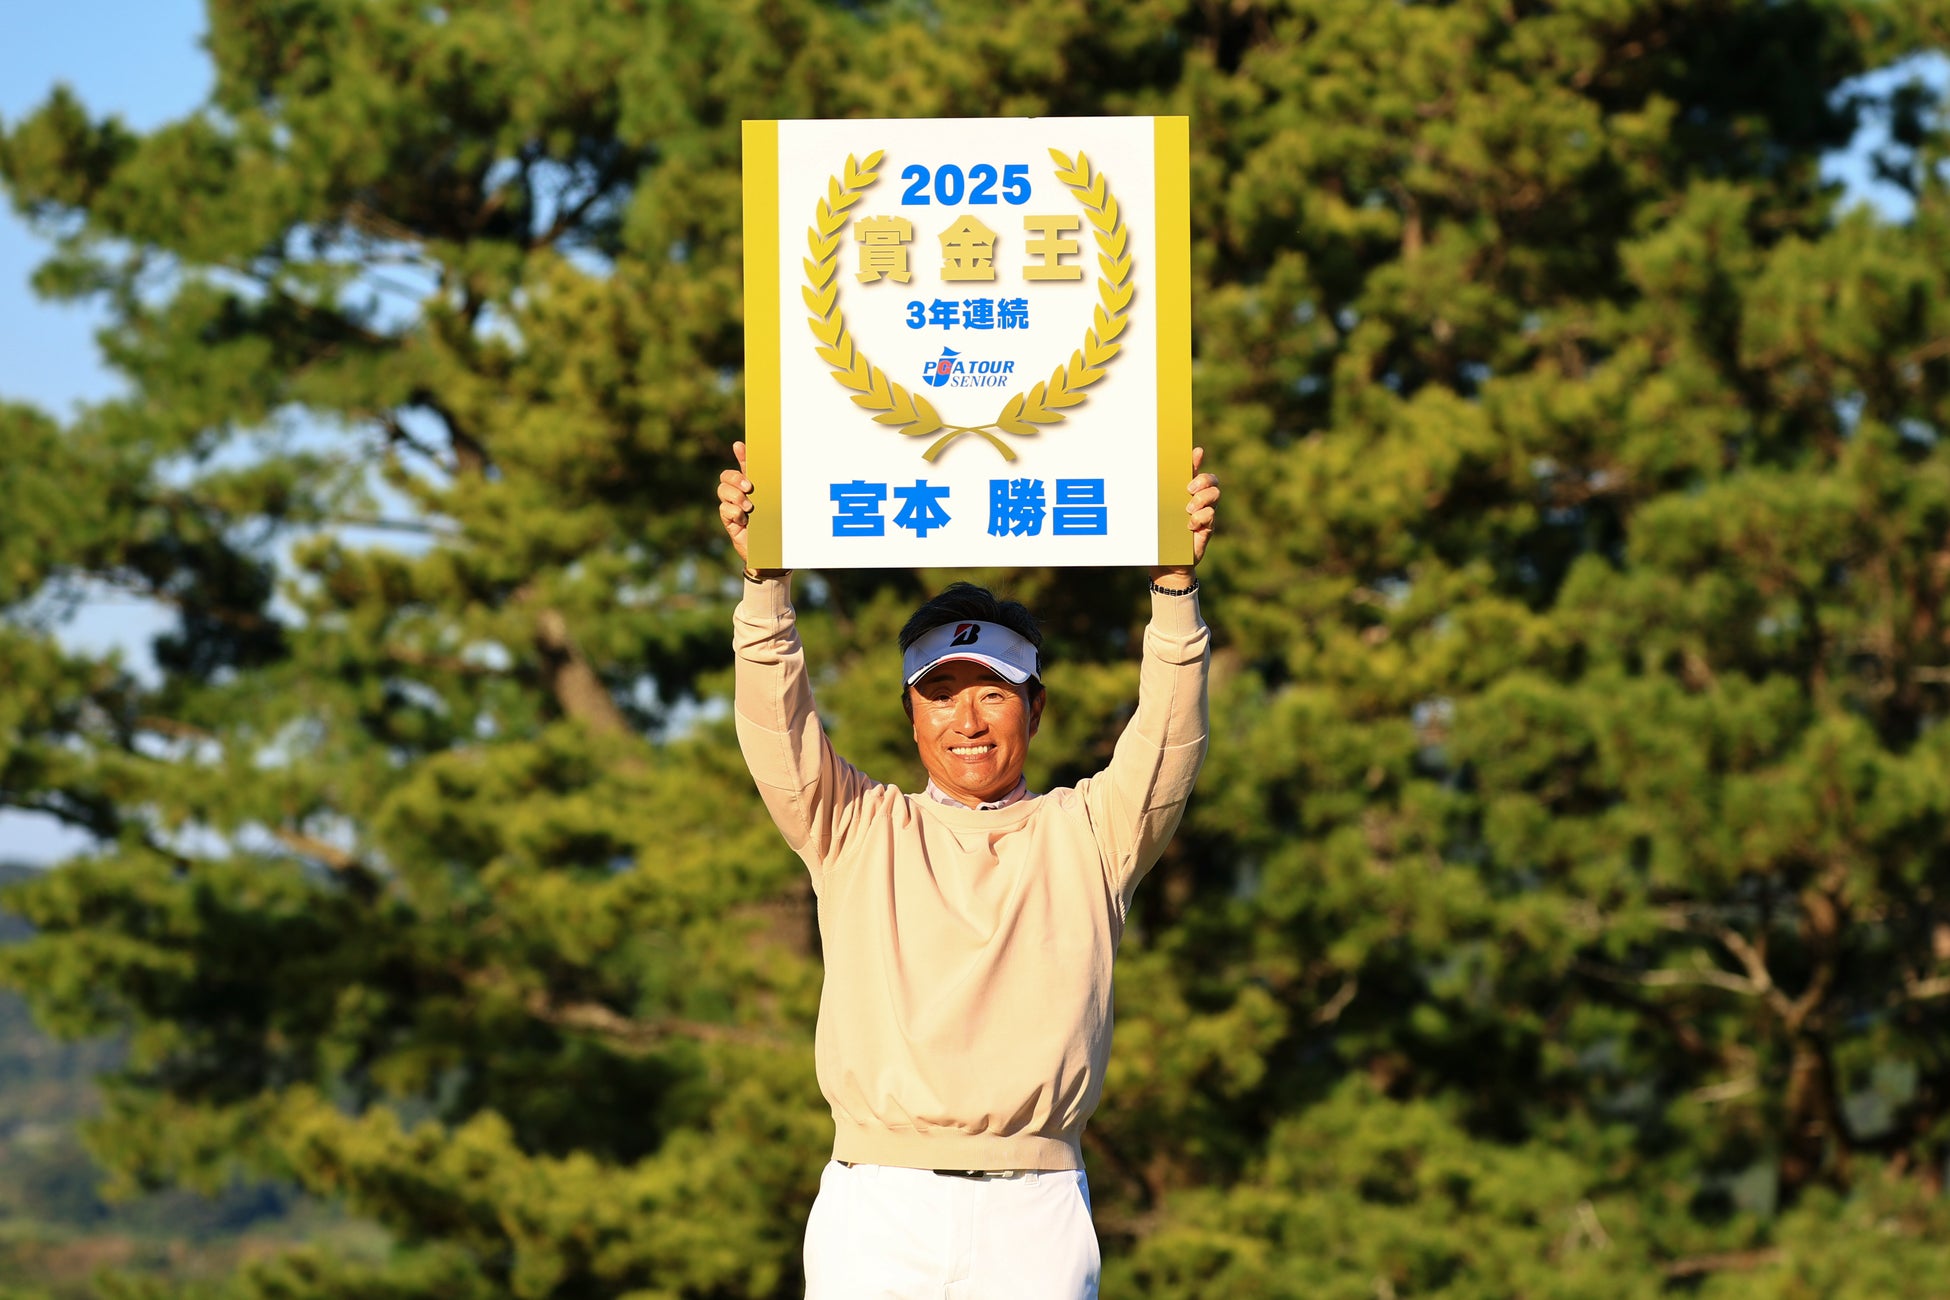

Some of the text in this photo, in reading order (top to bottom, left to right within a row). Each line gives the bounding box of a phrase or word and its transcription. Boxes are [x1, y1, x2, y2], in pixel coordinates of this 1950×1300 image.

[901, 164, 1031, 206] 2025
[853, 214, 1081, 284] 賞金王
[906, 298, 1029, 330] 3年連続
[923, 359, 1015, 375] PGA TOUR
[950, 375, 1008, 388] SENIOR
[829, 478, 1108, 538] 宮本 勝昌
